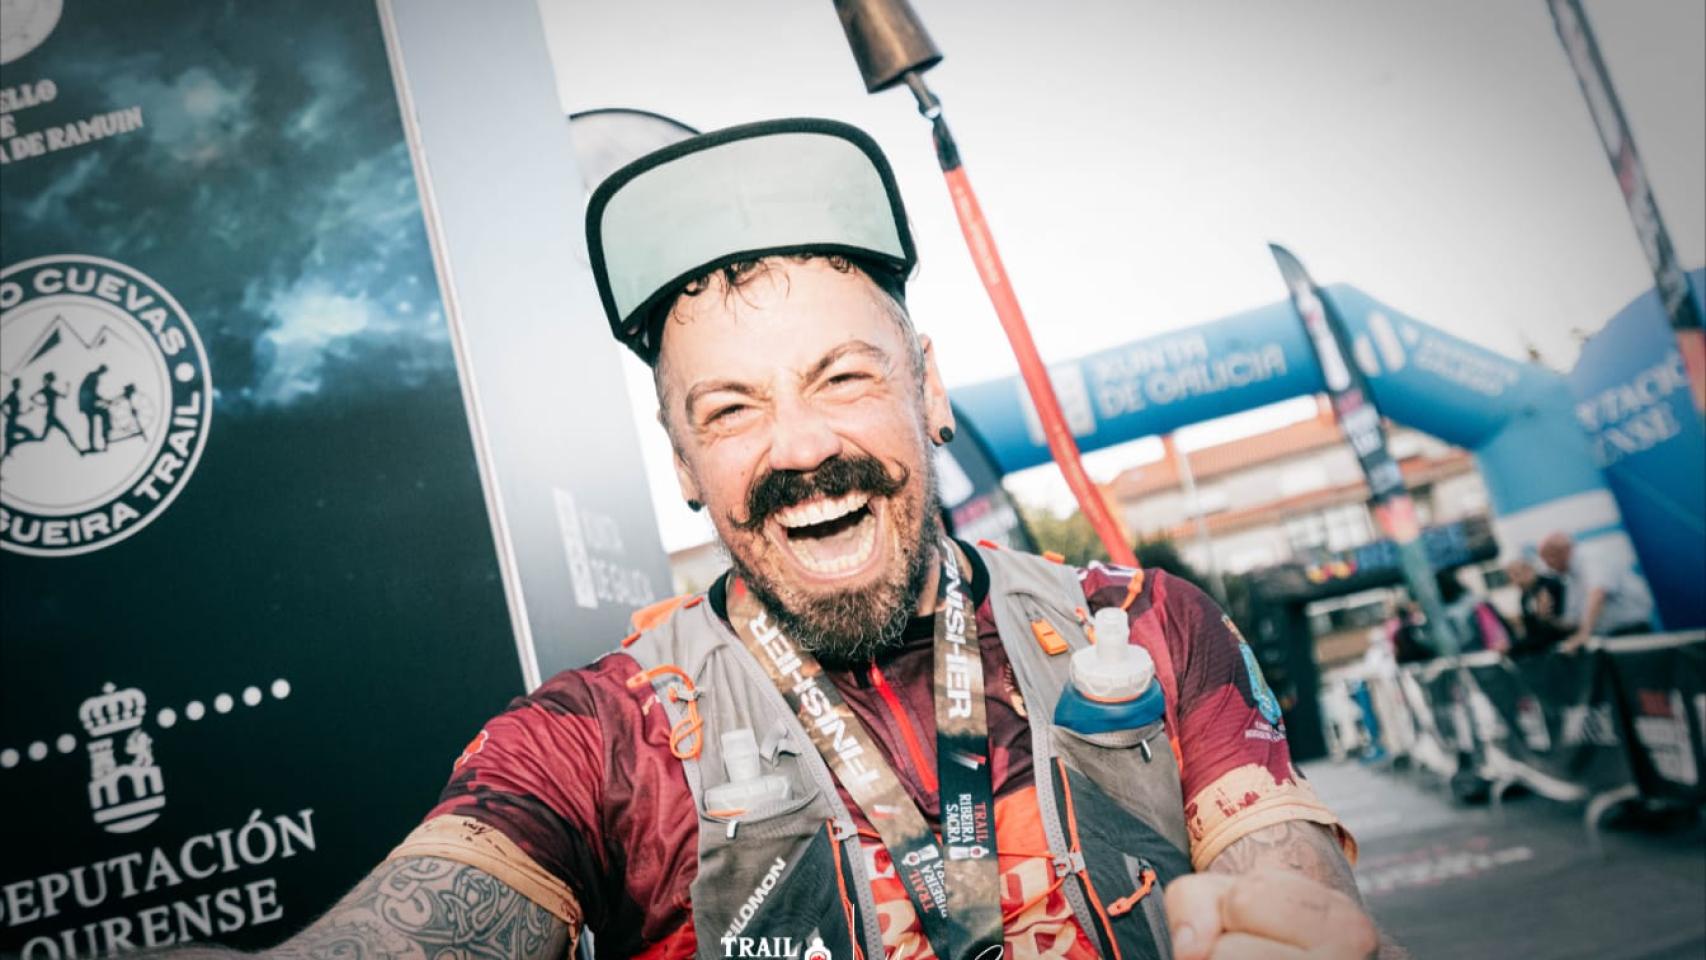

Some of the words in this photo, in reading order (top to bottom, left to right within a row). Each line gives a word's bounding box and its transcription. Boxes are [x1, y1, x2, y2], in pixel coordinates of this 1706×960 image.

[9, 132, 46, 161] DE
[33, 267, 187, 356] CUEVAS
[133, 391, 201, 501] TRAIL
[749, 610, 881, 786] FINISHER
[946, 803, 961, 843] SACRA
[959, 793, 975, 843] RIBEIRA
[974, 801, 989, 843] TRAIL
[0, 808, 317, 927] EPUTACIÓN
[21, 878, 284, 960] OURENSE
